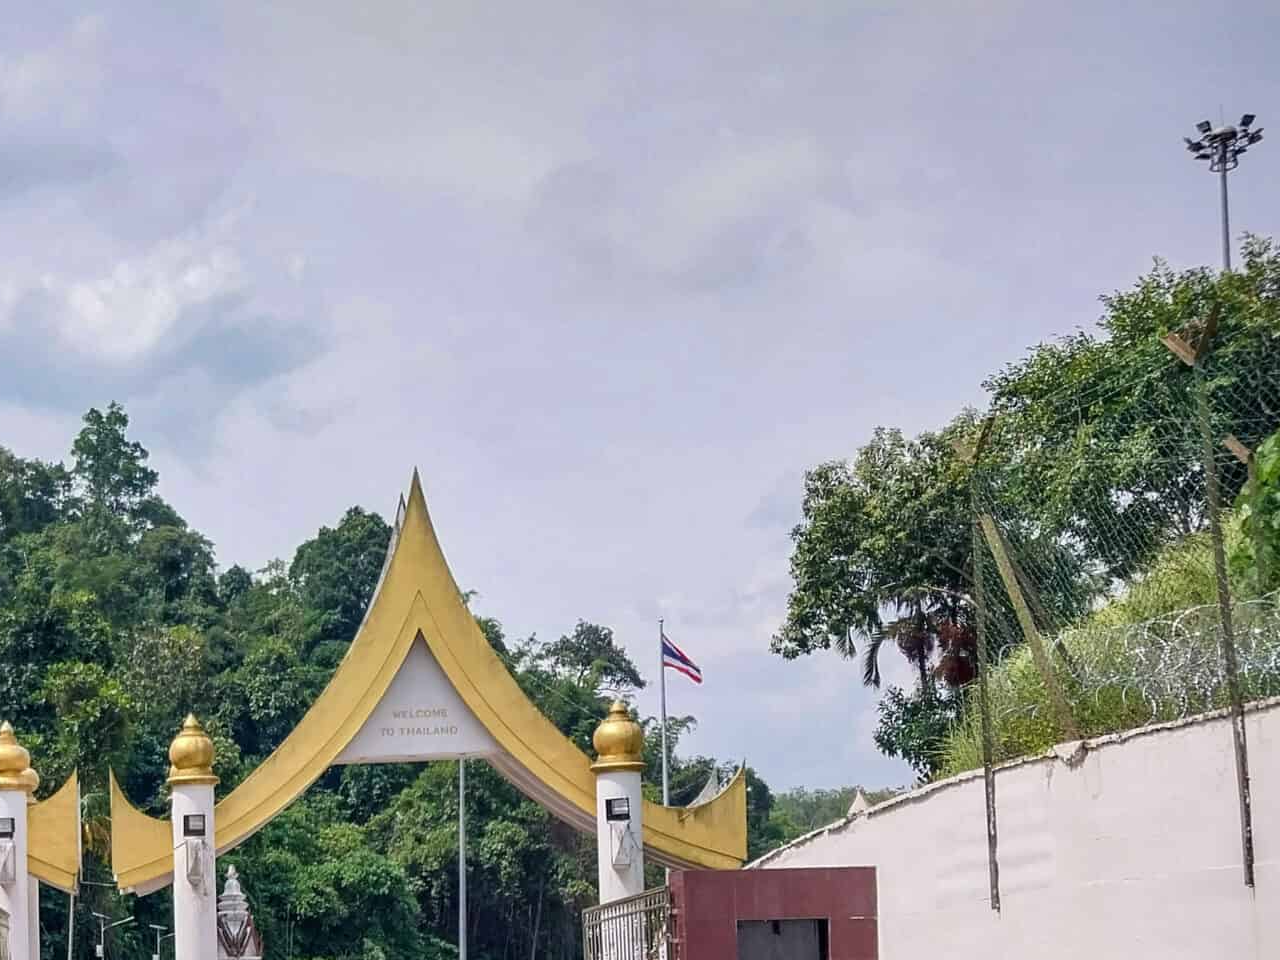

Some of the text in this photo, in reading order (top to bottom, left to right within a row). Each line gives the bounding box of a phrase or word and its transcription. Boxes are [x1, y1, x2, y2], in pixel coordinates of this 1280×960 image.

[392, 708, 448, 719] WELCOME
[381, 726, 458, 737] TO THAILAND
